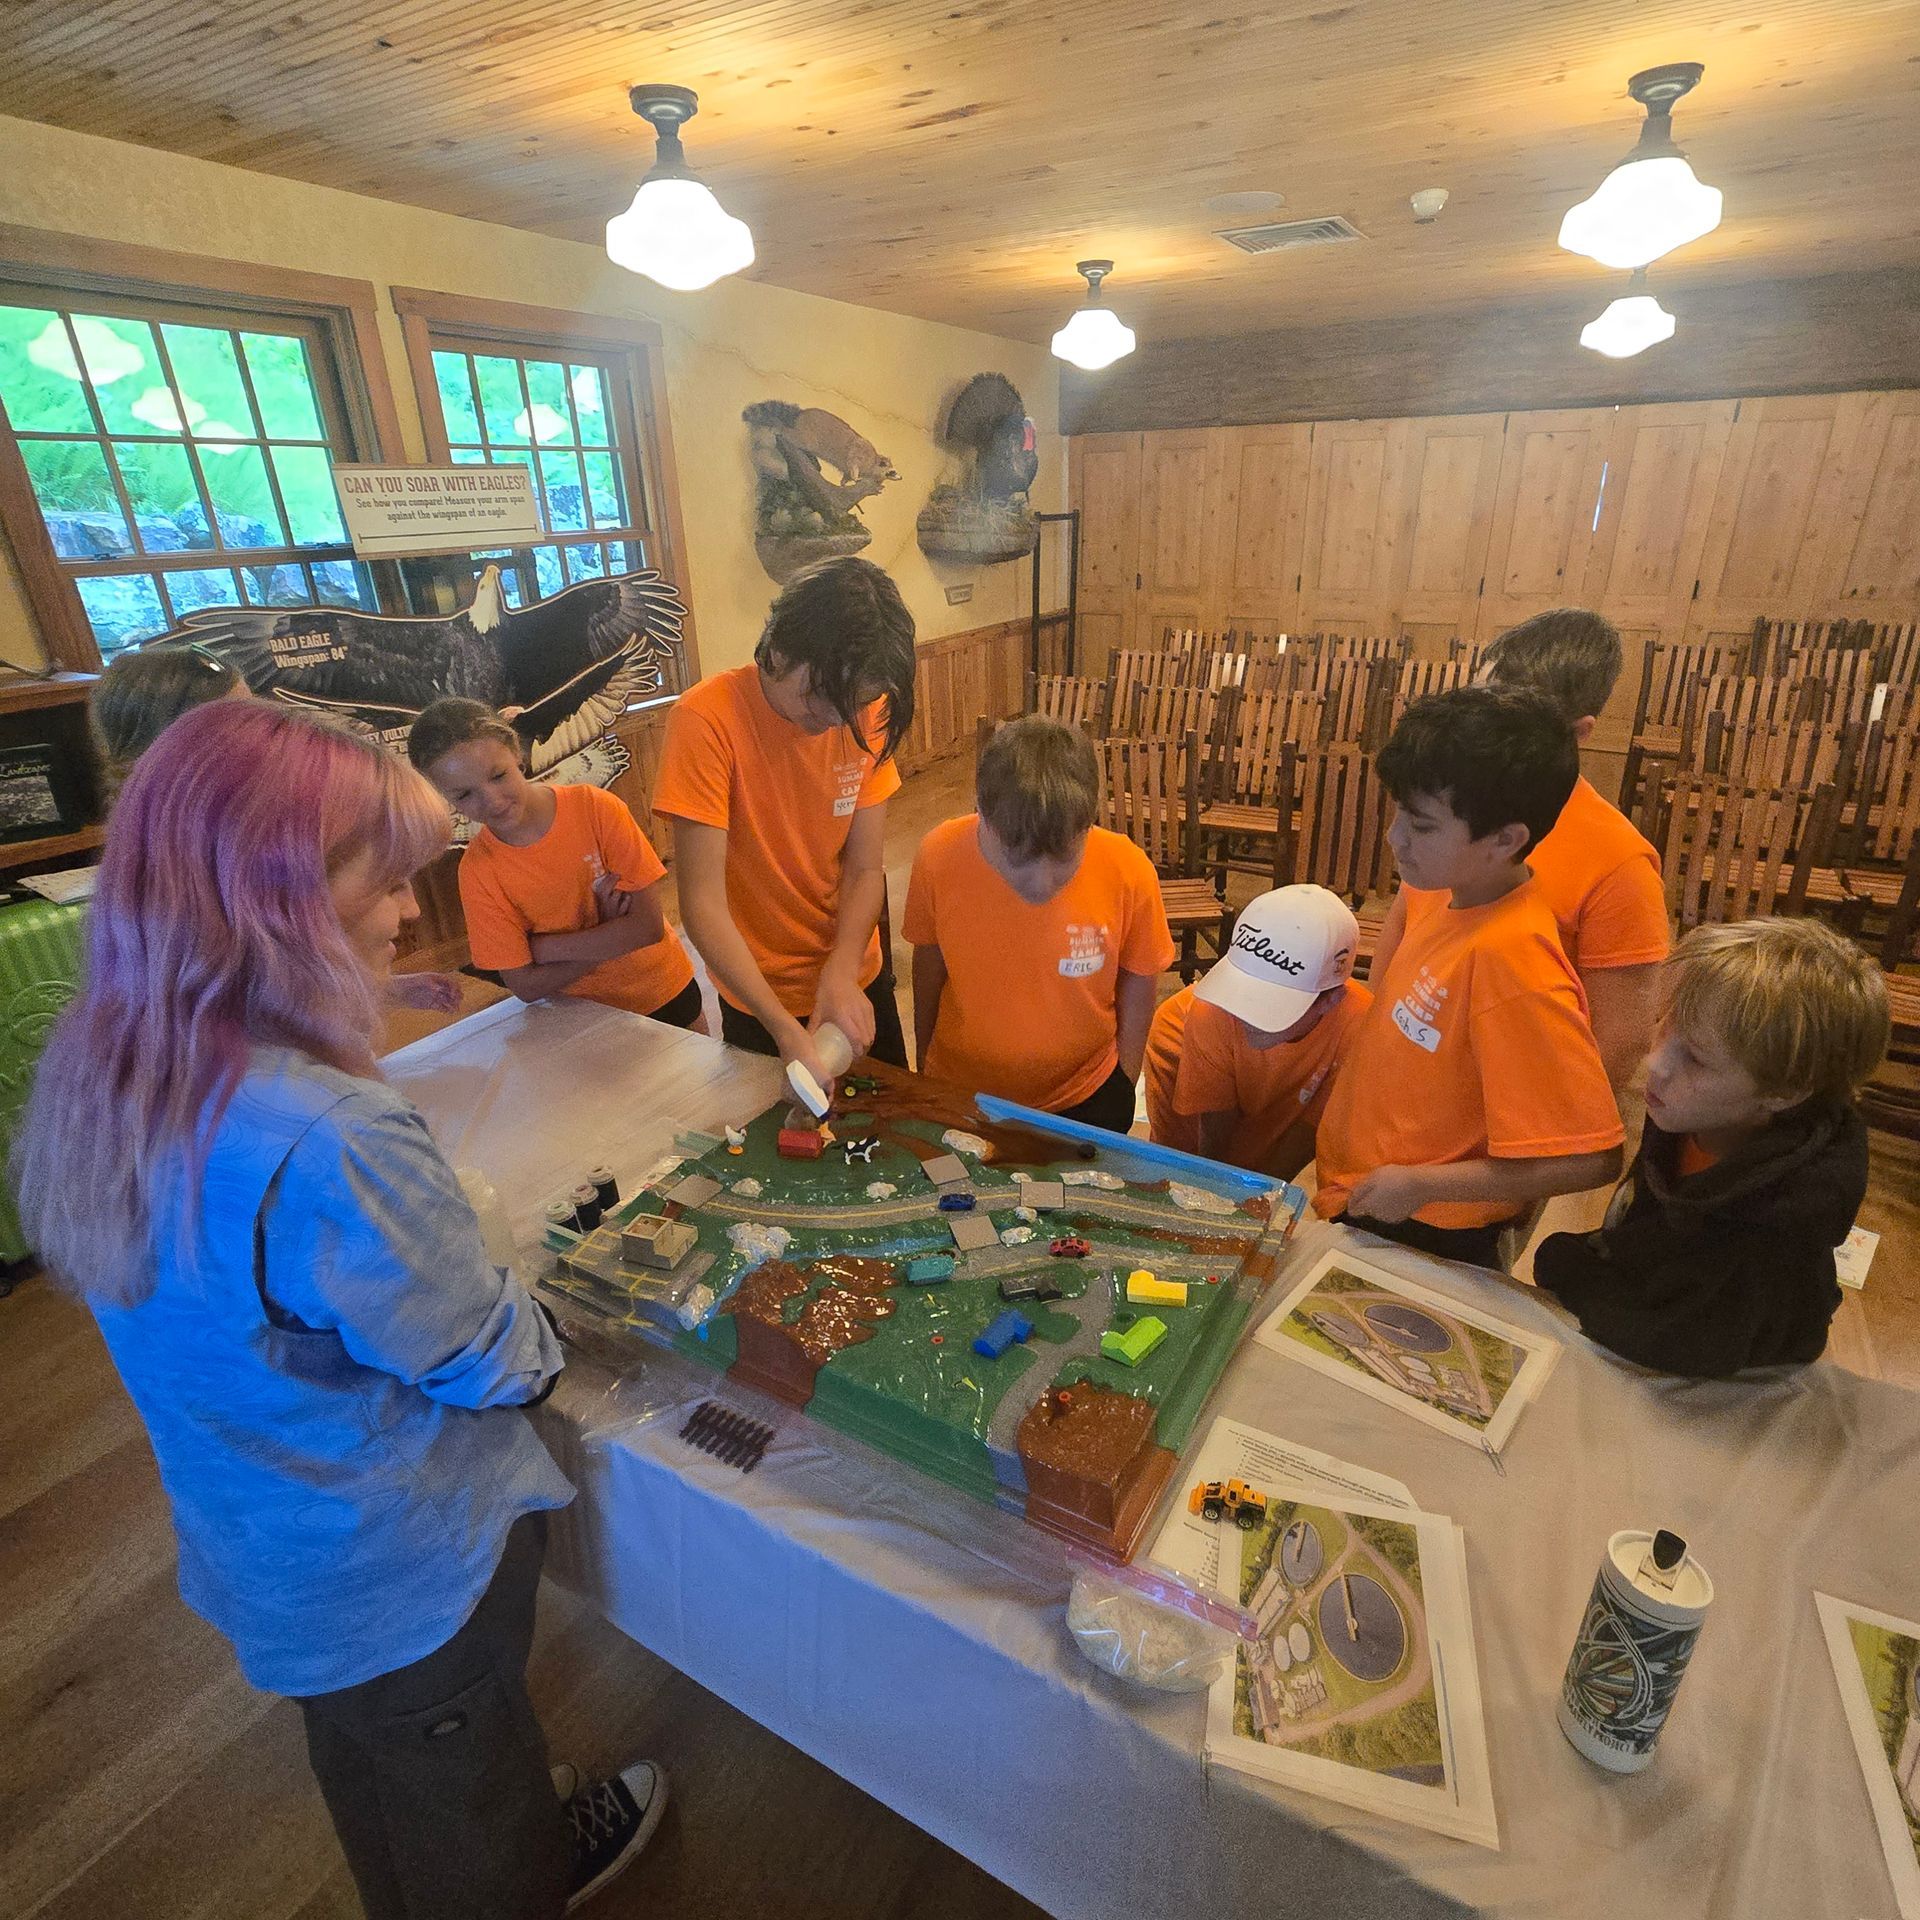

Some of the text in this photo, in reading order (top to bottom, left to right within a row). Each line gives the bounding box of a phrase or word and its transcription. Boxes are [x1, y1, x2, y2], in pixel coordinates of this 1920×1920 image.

[343, 475, 526, 494] CAN YOU SOAR WITH EAGLES?
[356, 495, 525, 509] See how you compare! Measure your arm span
[387, 510, 416, 523] against
[418, 509, 431, 519] the
[432, 509, 468, 521] wingspan
[469, 507, 476, 518] of
[477, 508, 487, 517] an
[269, 632, 332, 653] BALD EAGLE
[273, 651, 330, 669] Wingspan:
[1230, 923, 1305, 976] Titleist
